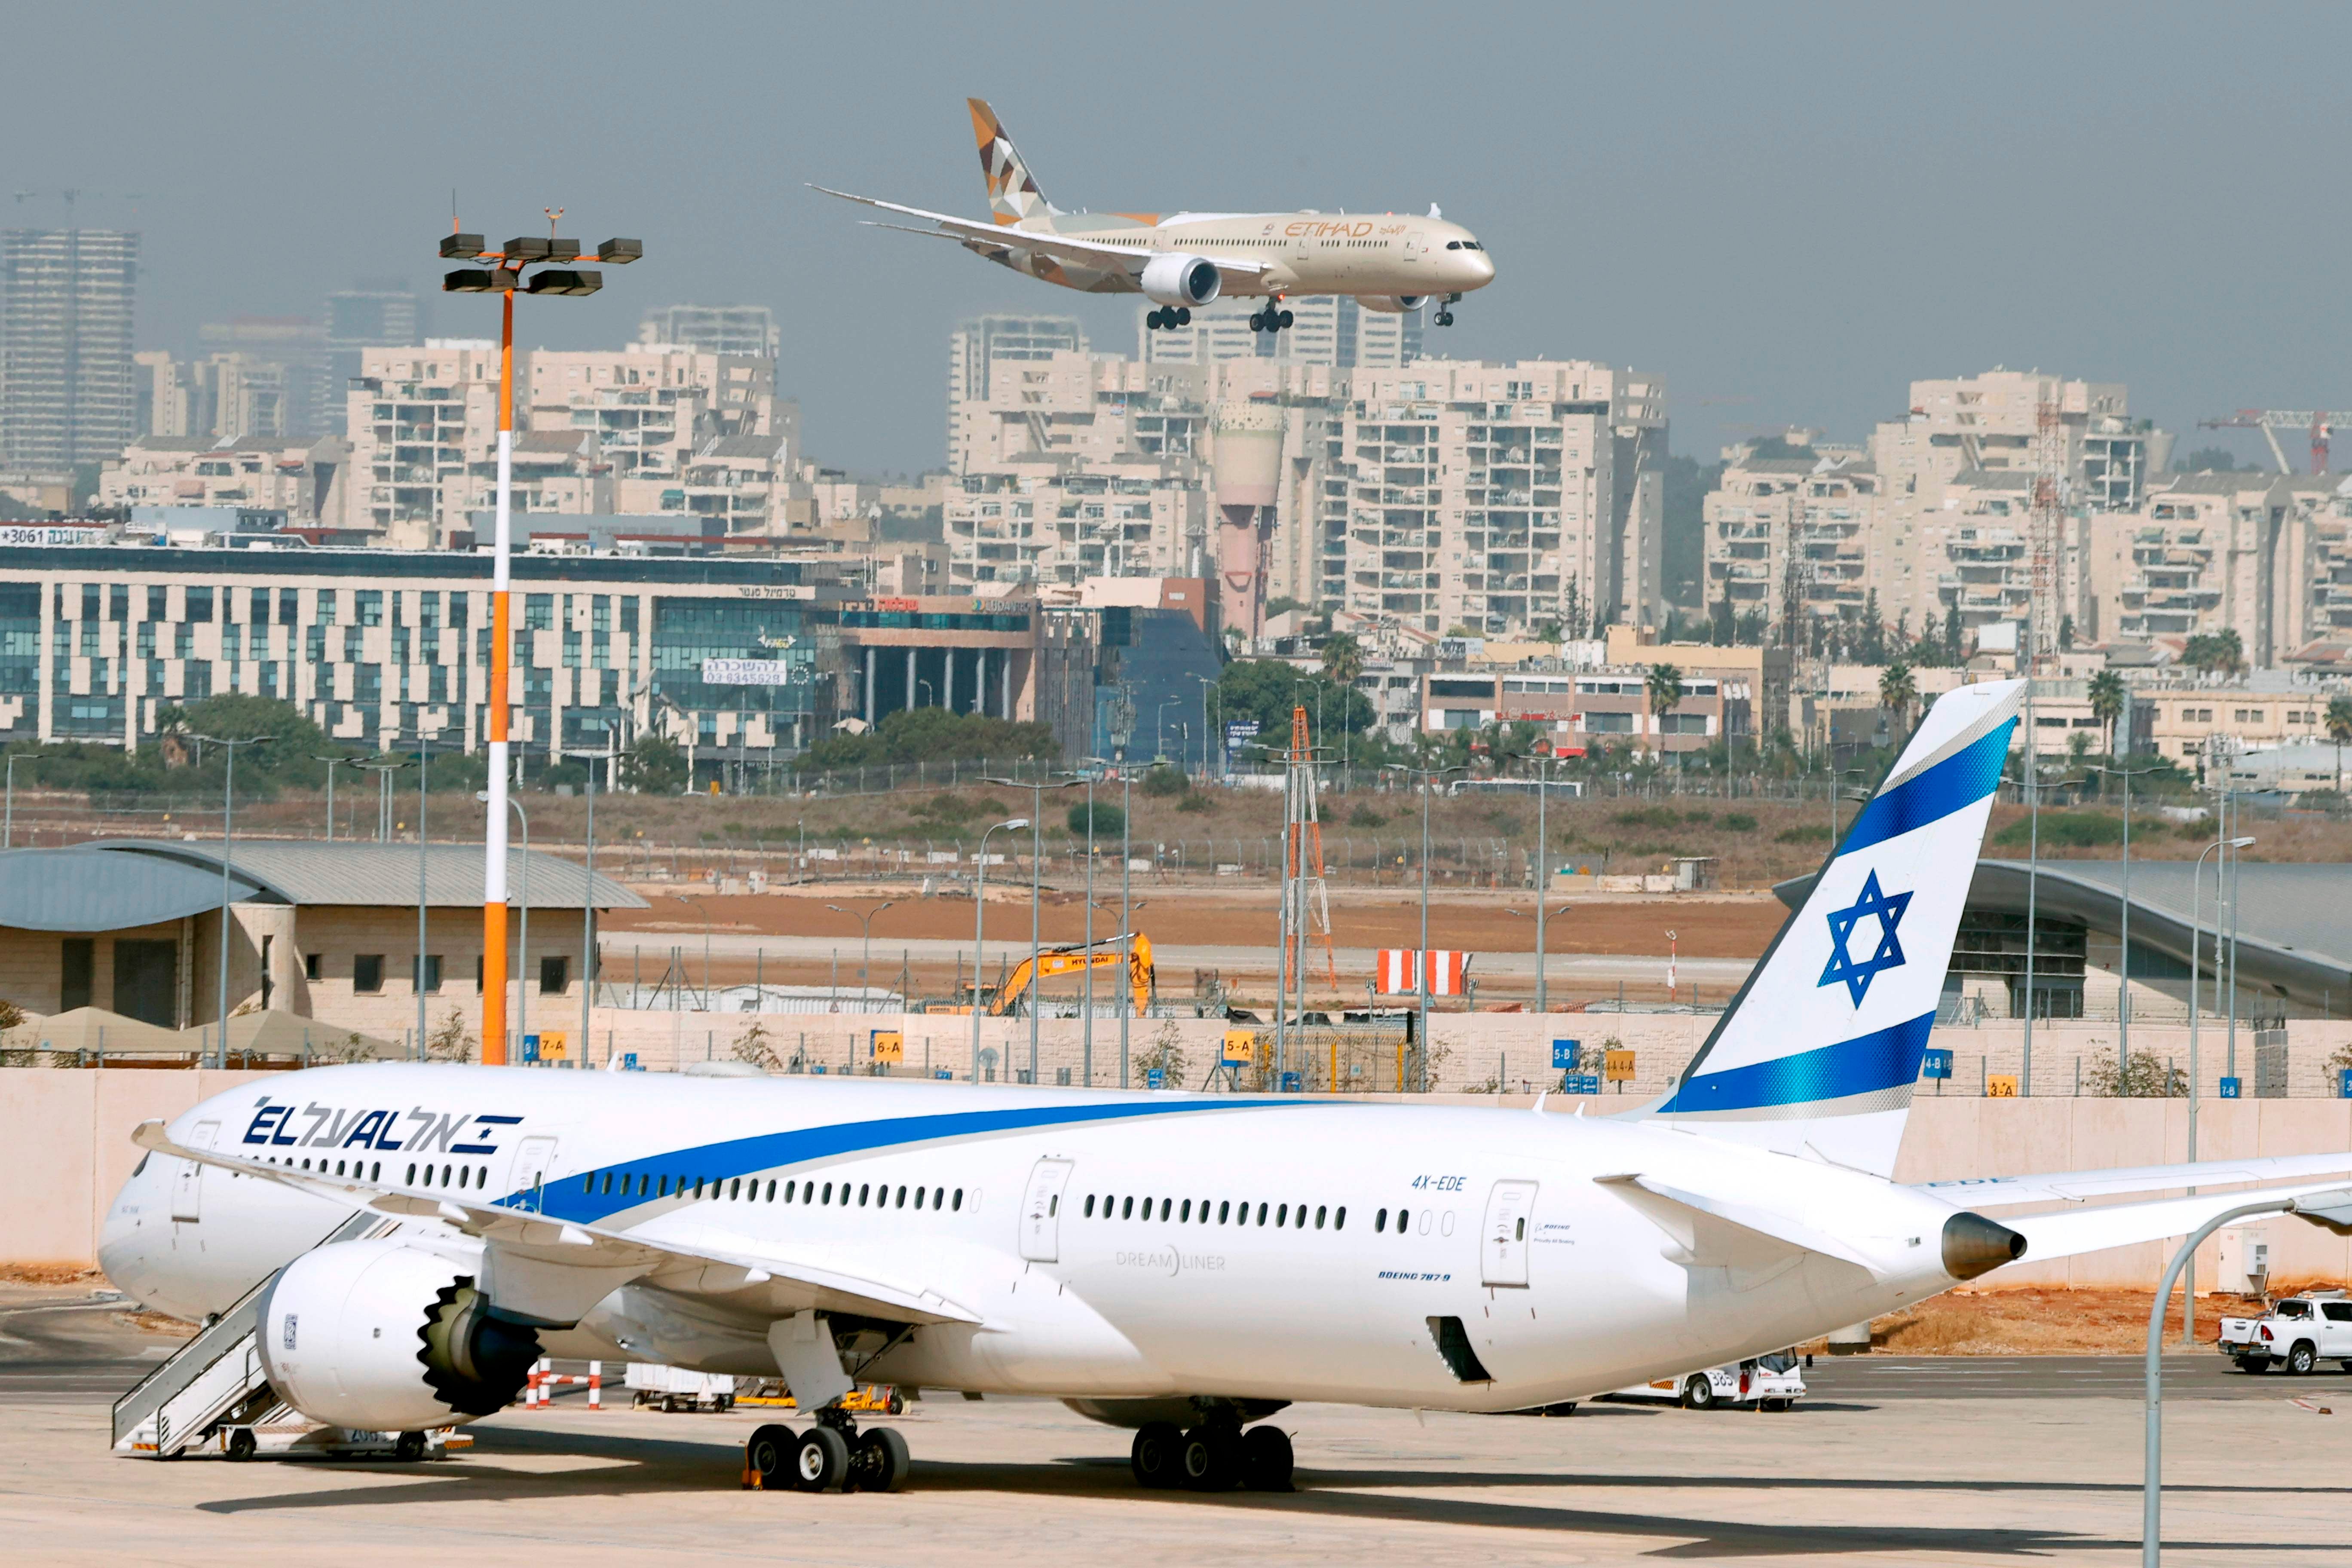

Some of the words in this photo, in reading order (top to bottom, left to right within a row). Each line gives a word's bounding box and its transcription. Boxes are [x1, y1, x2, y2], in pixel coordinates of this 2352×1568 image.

[1285, 222, 1373, 237] ETIHAD
[708, 661, 778, 671] להשכרה
[542, 1039, 563, 1050] 7-A
[878, 1042, 900, 1053] 6-A
[1227, 1041, 1250, 1051] 5-A
[1554, 1049, 1570, 1060] 5-B
[1619, 1060, 1634, 1072] 4-A
[1926, 1057, 1940, 1069] 4-B
[1991, 1083, 2013, 1096] 3-A
[2222, 1086, 2235, 1096] 7-B
[1412, 1175, 1467, 1191] 4X-EDE
[1378, 1271, 1418, 1280] BOEING
[1709, 1372, 1733, 1386] 385
